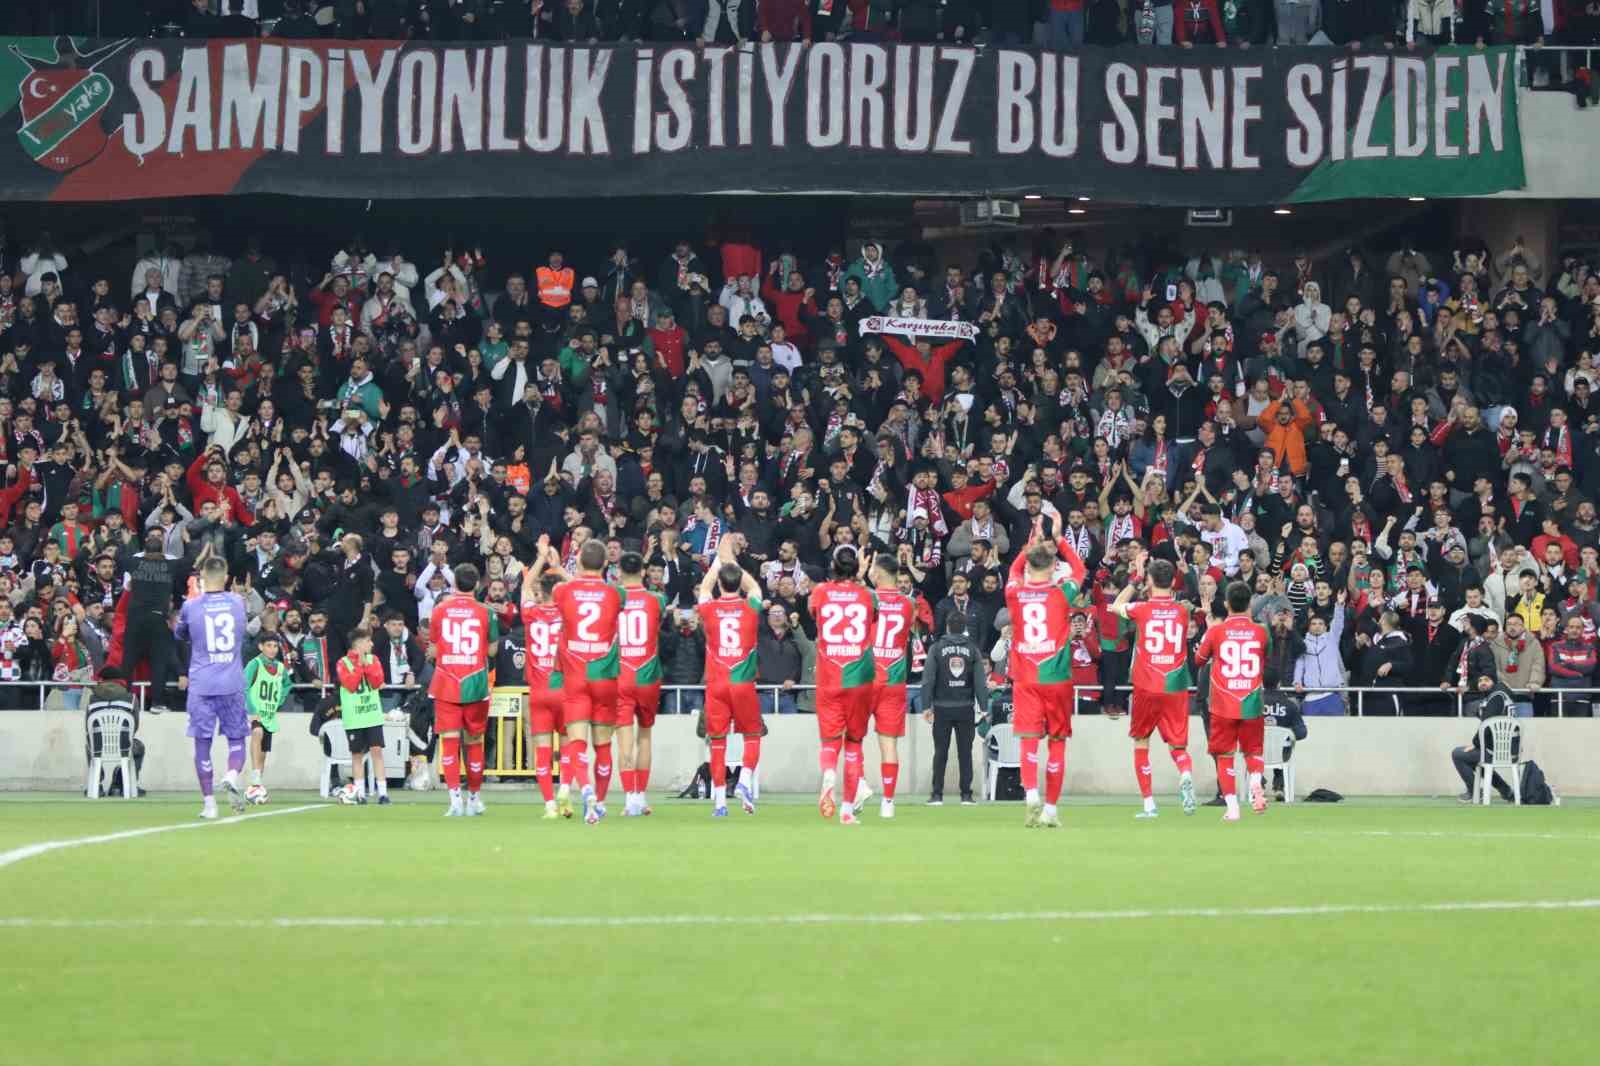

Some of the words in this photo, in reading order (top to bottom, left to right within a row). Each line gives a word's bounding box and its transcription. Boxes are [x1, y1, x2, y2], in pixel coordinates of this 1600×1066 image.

[122, 44, 611, 165] ŞAMPİYONLUK
[633, 42, 975, 154] İSTİYORUZ
[998, 50, 1078, 157] BU
[1102, 63, 1262, 168] SENE
[1286, 53, 1507, 167] SİZDEN
[204, 611, 235, 652] 13
[441, 618, 480, 655] 45
[577, 602, 600, 641] 2
[618, 609, 648, 646] 10
[719, 617, 741, 649] 6
[821, 603, 867, 643] 23
[876, 614, 904, 647] 17
[1022, 602, 1047, 643] 8
[1145, 620, 1182, 653] 54
[1220, 640, 1261, 678] 95
[1263, 703, 1286, 717] OLİS
